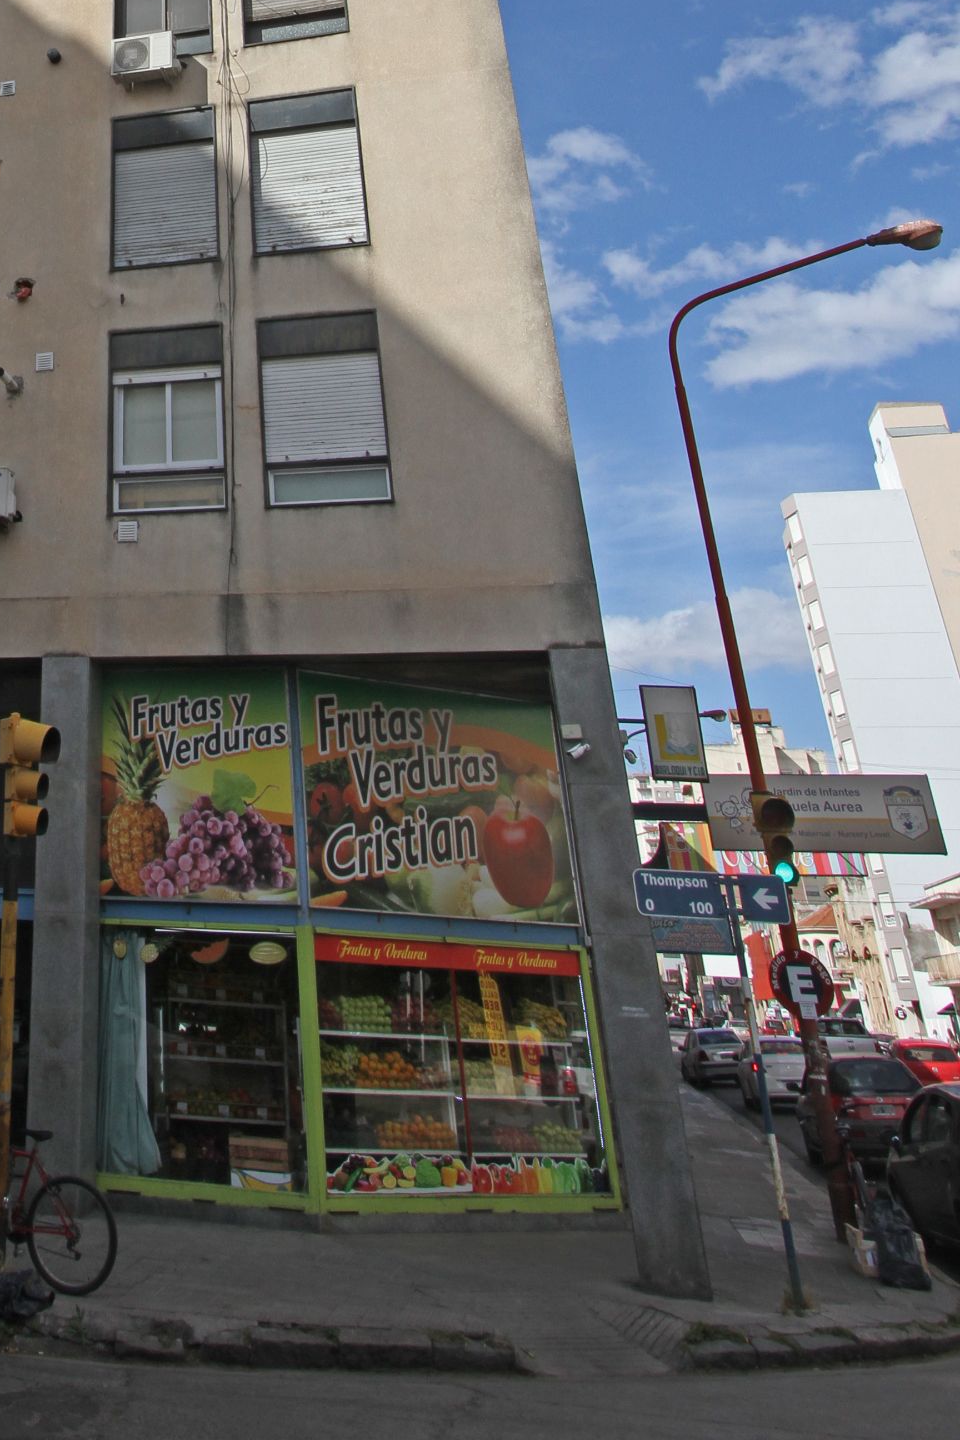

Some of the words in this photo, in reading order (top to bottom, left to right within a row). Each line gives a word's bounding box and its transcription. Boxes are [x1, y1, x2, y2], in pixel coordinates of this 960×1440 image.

[131, 695, 222, 739] Frutas
[231, 694, 250, 726] y
[316, 695, 423, 754] Frutas
[434, 709, 452, 750] y
[157, 720, 288, 772] Verduras
[350, 748, 497, 807] Verduras
[805, 788, 816, 797] de
[819, 788, 861, 797] Infantes
[823, 801, 863, 812] Aurea
[324, 805, 478, 882] Cristian
[640, 873, 708, 889] Thompson
[645, 898, 655, 911] 0
[689, 901, 713, 914] 100
[337, 940, 371, 958] Frutas
[373, 949, 380, 960] y
[385, 943, 428, 960] Verduras
[474, 949, 505, 967] Frutas
[507, 957, 514, 968] y
[517, 951, 557, 969] Verduras
[771, 955, 786, 990] Medido
[810, 957, 831, 985] Pago
[786, 965, 819, 1003] E
